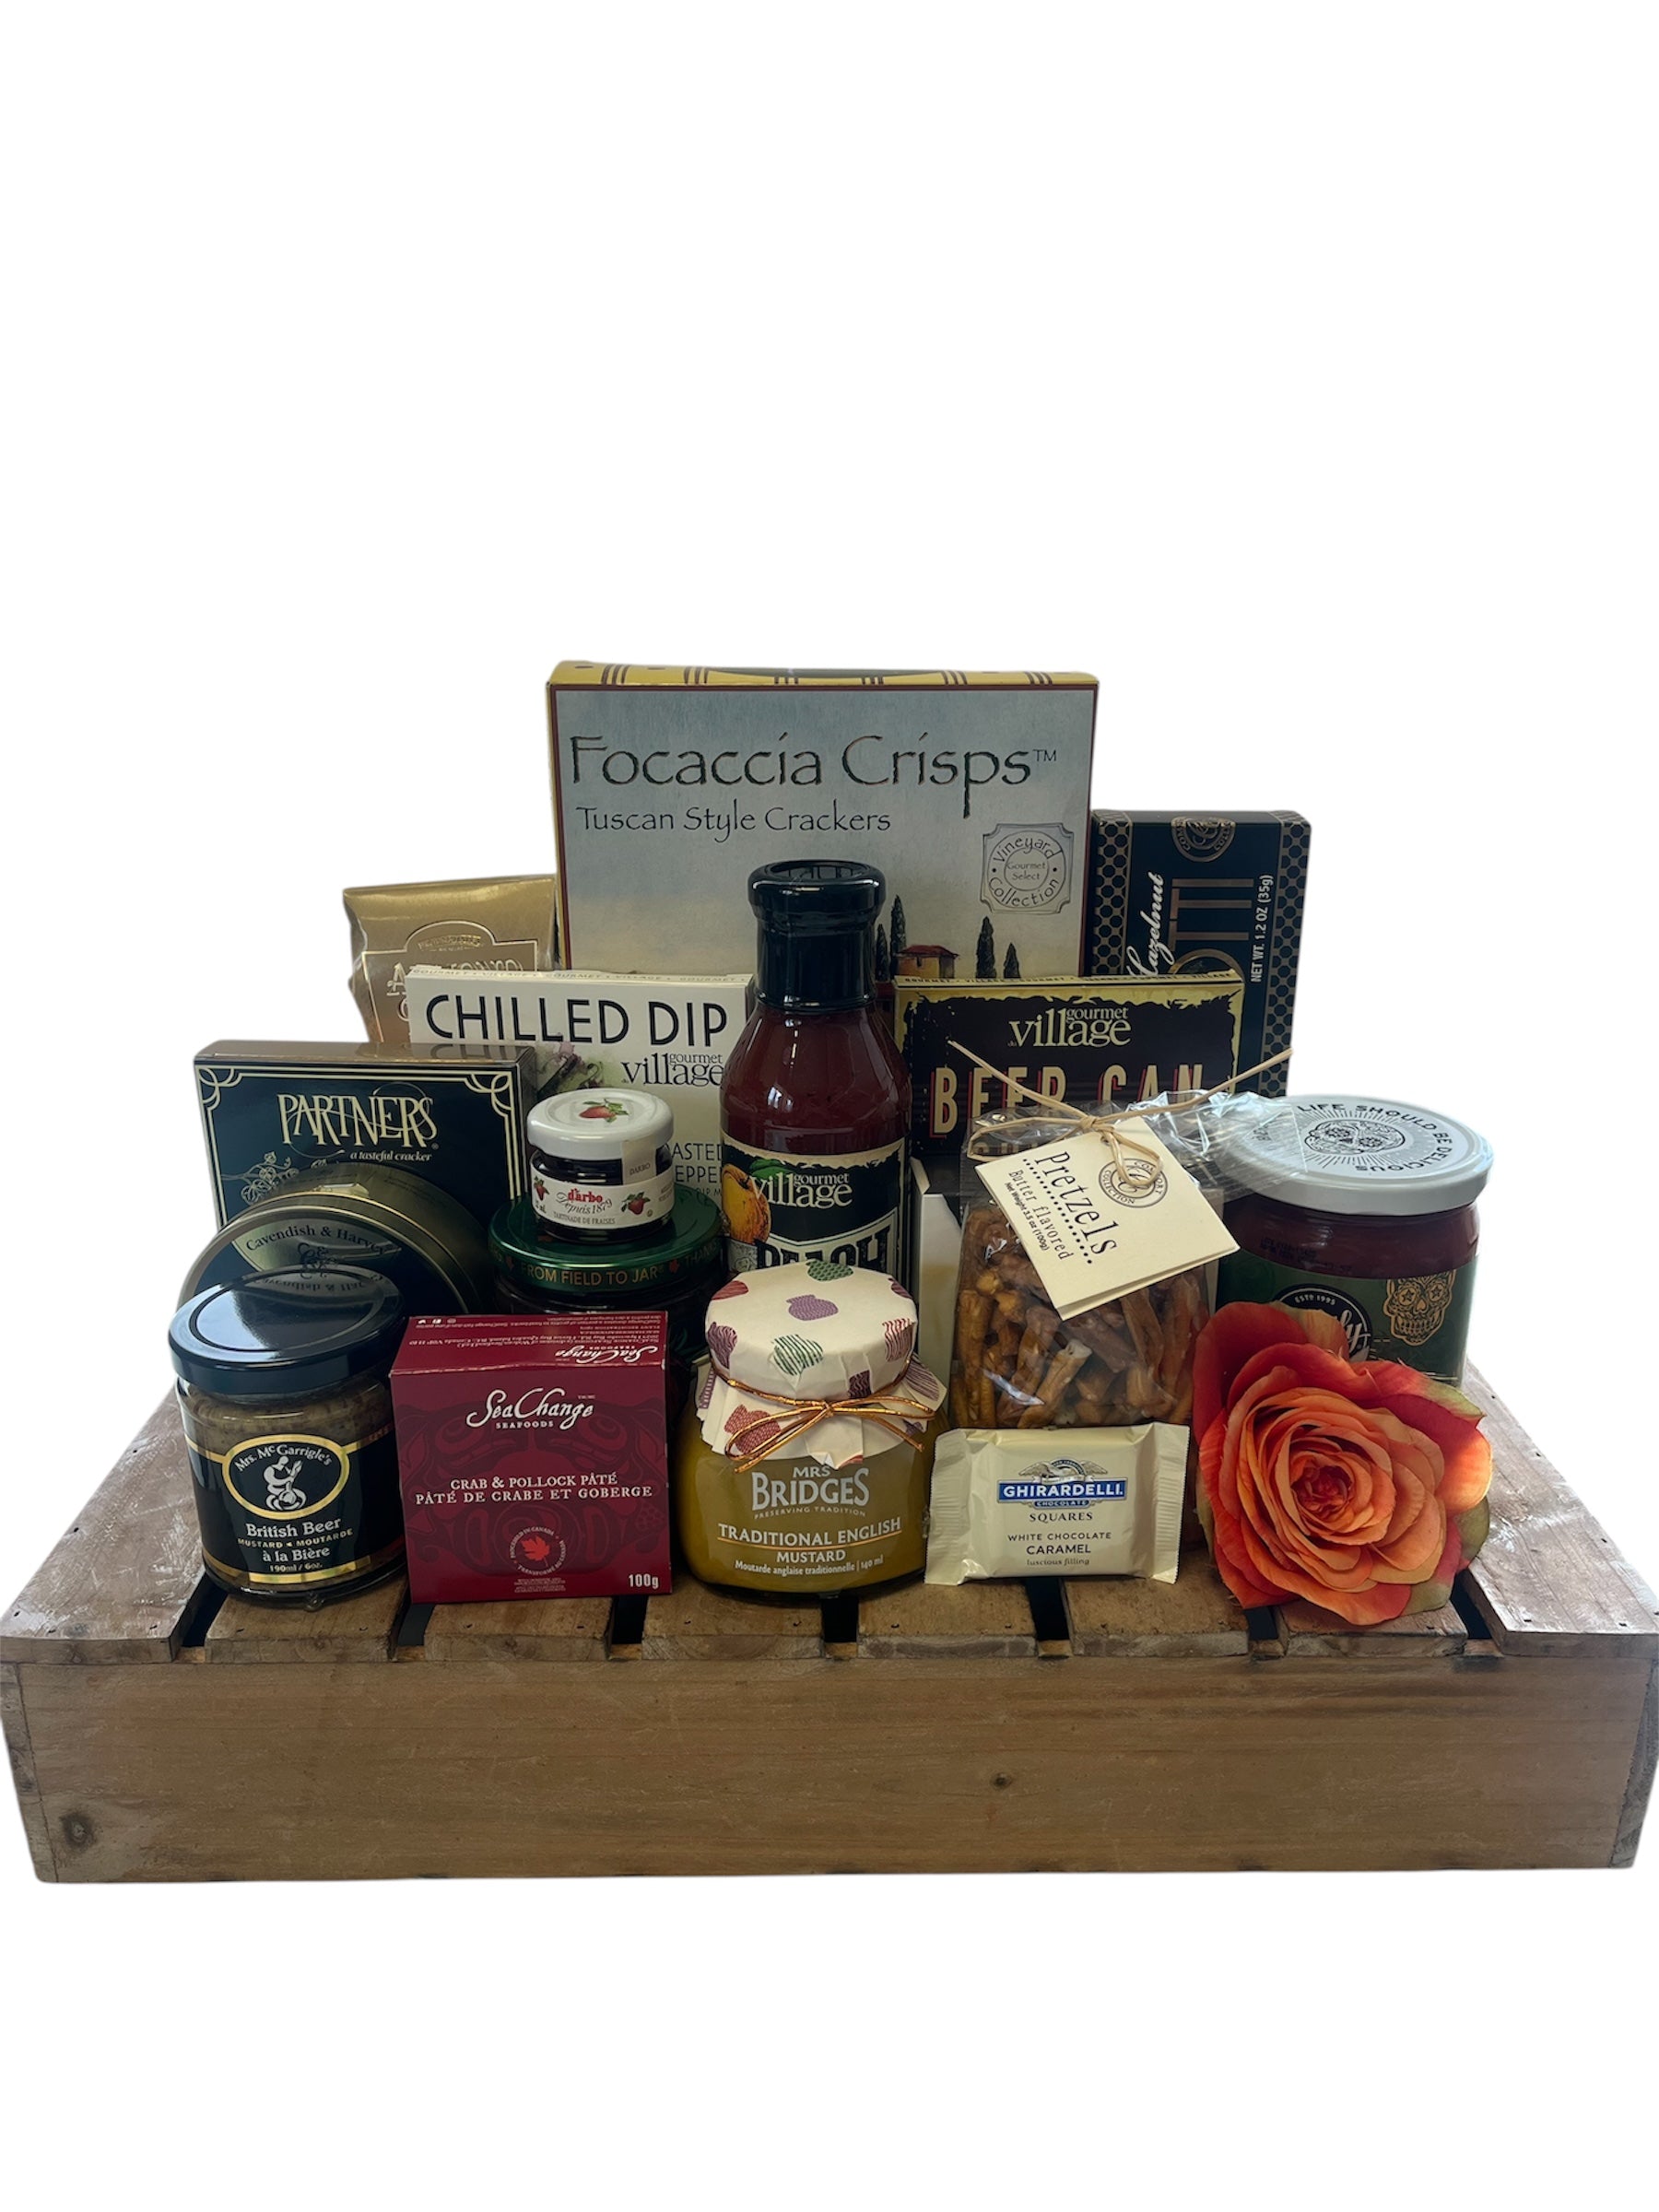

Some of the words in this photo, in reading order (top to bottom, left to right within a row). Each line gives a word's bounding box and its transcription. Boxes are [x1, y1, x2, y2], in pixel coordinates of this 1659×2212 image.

[570, 734, 821, 785] Focaccia
[576, 806, 674, 830] Tuscan
[684, 799, 756, 842] Style
[765, 799, 891, 831] Crackers
[993, 838, 1063, 862] Vineyard
[1012, 870, 1040, 880] Select
[989, 877, 1059, 906] Collection
[1258, 875, 1274, 903] (35g)
[1255, 906, 1268, 924] OZ
[1255, 925, 1266, 941] 1.2
[1252, 942, 1264, 959] WT.
[1251, 959, 1262, 983] NET
[426, 994, 629, 1044] CHILLED
[648, 1001, 727, 1047] DIP
[1066, 1006, 1128, 1022] gourmet
[1009, 1008, 1133, 1047] village
[669, 1053, 723, 1065] gourmet
[621, 1053, 724, 1086] village
[1297, 1103, 1346, 1112] LIFE
[1356, 1105, 1437, 1130] SHOULD
[1432, 1133, 1453, 1144] BE
[359, 1150, 393, 1162] tasteful
[394, 1151, 432, 1161] cracker
[1355, 1147, 1453, 1171] DELICIOUS
[794, 1172, 849, 1186] gourmet
[1005, 1182, 1015, 1192] Net
[1103, 1170, 1135, 1204] COLLECTION
[751, 1171, 853, 1209] village
[556, 1192, 591, 1215] Depuis
[592, 1200, 613, 1214] 1879
[1012, 1191, 1027, 1211] Weight
[1034, 1151, 1119, 1254] Pretzels
[1009, 1170, 1037, 1201] Butter
[1032, 1206, 1075, 1260] flavored
[1023, 1210, 1033, 1219] 3.5
[1029, 1220, 1037, 1230] oz
[246, 1225, 315, 1251] Cavendish
[321, 1226, 331, 1237] &
[1032, 1229, 1050, 1251] (100g)
[522, 1265, 557, 1283] FROM
[561, 1269, 603, 1286] FIELD
[606, 1270, 628, 1284] TO
[555, 1346, 658, 1364] SeaChange
[465, 1387, 594, 1430] SeaChange
[496, 1420, 554, 1430] SEAFOODS
[234, 1455, 258, 1472] Mrs.
[793, 1466, 830, 1477] MRS
[450, 1478, 488, 1491] CRAB
[491, 1477, 505, 1488] &
[509, 1475, 576, 1488] POLLOCK
[580, 1472, 618, 1486] PÂTÉ
[751, 1467, 869, 1511] BRIDGES
[415, 1490, 457, 1505] PÂTÉ
[463, 1491, 486, 1503] DE
[491, 1489, 544, 1502] CRABE
[549, 1488, 571, 1500] ET
[578, 1486, 653, 1500] GOBERGE
[754, 1506, 811, 1520] PRESERVING
[814, 1506, 866, 1517] TRADITION
[1029, 1512, 1093, 1524] SQUARES
[245, 1523, 298, 1538] British
[301, 1518, 341, 1535] Beer
[718, 1523, 832, 1547] TRADITIONAL
[837, 1517, 901, 1544] ENGLISH
[1007, 1533, 1043, 1542] WHITE
[1047, 1532, 1112, 1541] CHOCOLATE
[237, 1537, 283, 1548] MUSTARD
[296, 1528, 353, 1547] MOUTARDE
[263, 1550, 271, 1562] à
[275, 1550, 288, 1562] la
[292, 1547, 330, 1561] Bière
[776, 1549, 846, 1564] MUSTARD
[1026, 1544, 1091, 1555] CARAMEL
[269, 1563, 296, 1571] 190ml
[735, 1559, 771, 1574] Moutarde
[772, 1564, 804, 1577] anglaise
[805, 1561, 856, 1575] traditionnelle
[860, 1559, 873, 1571] 140
[874, 1554, 884, 1566] ml
[1064, 1558, 1090, 1566] filling
[628, 1573, 659, 1590] 100g
